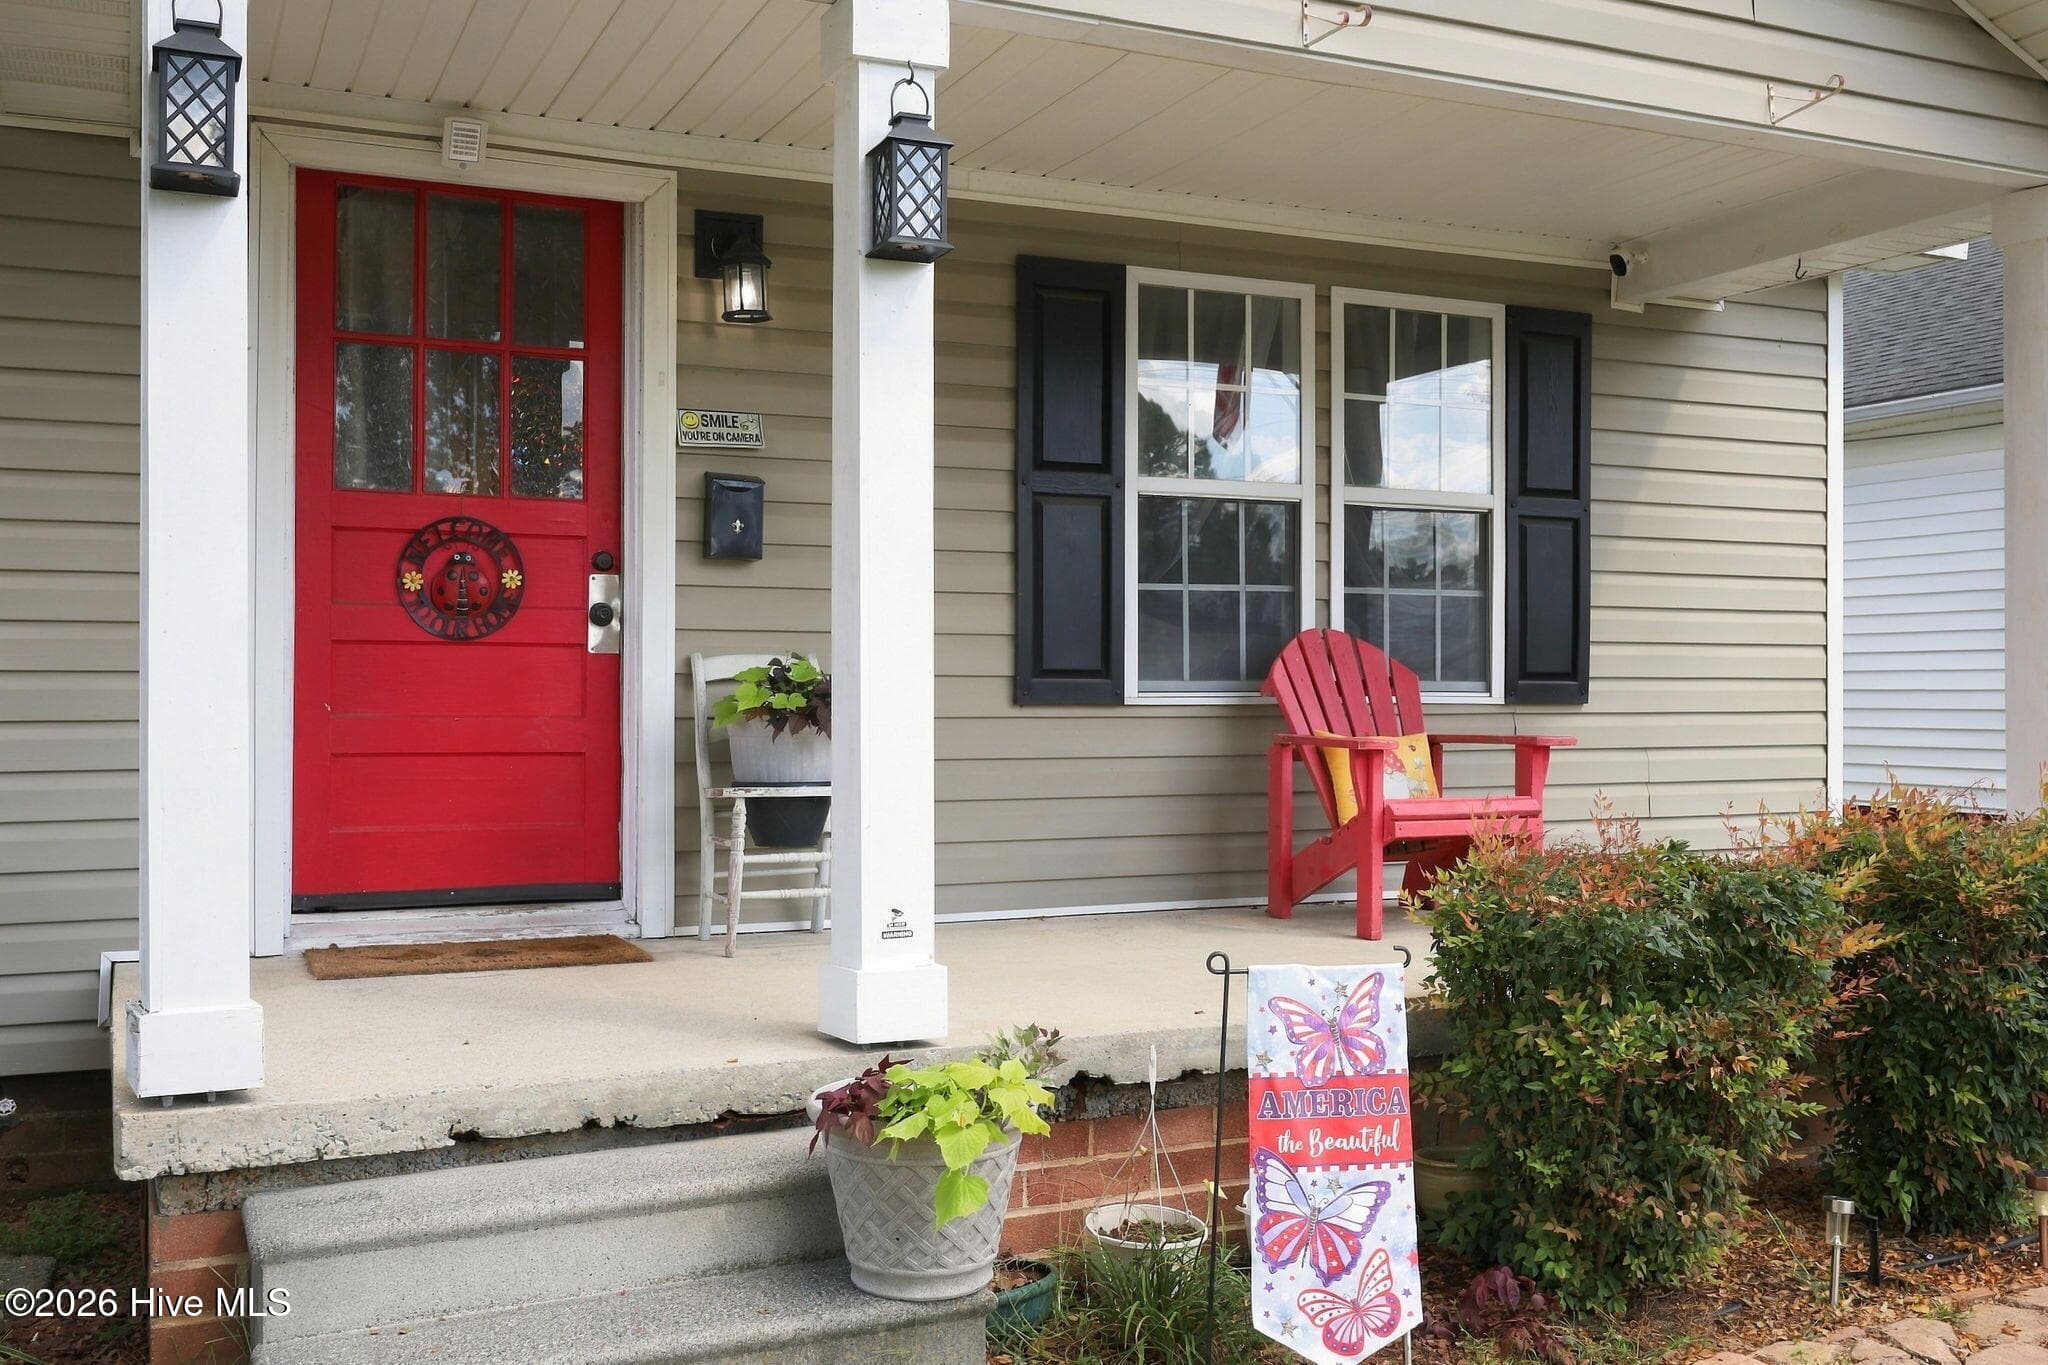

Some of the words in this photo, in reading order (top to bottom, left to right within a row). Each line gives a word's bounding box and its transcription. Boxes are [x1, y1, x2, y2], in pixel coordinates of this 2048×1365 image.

[701, 414, 739, 429] SMILE
[682, 430, 711, 441] YOU'RE
[712, 432, 725, 442] ON
[725, 432, 761, 443] CAMERA
[401, 519, 517, 565] WELCOME
[882, 930, 913, 939] WARNING
[1257, 1087, 1408, 1120] AMERICA
[1276, 1129, 1303, 1154] the
[1308, 1118, 1401, 1158] Beautiful
